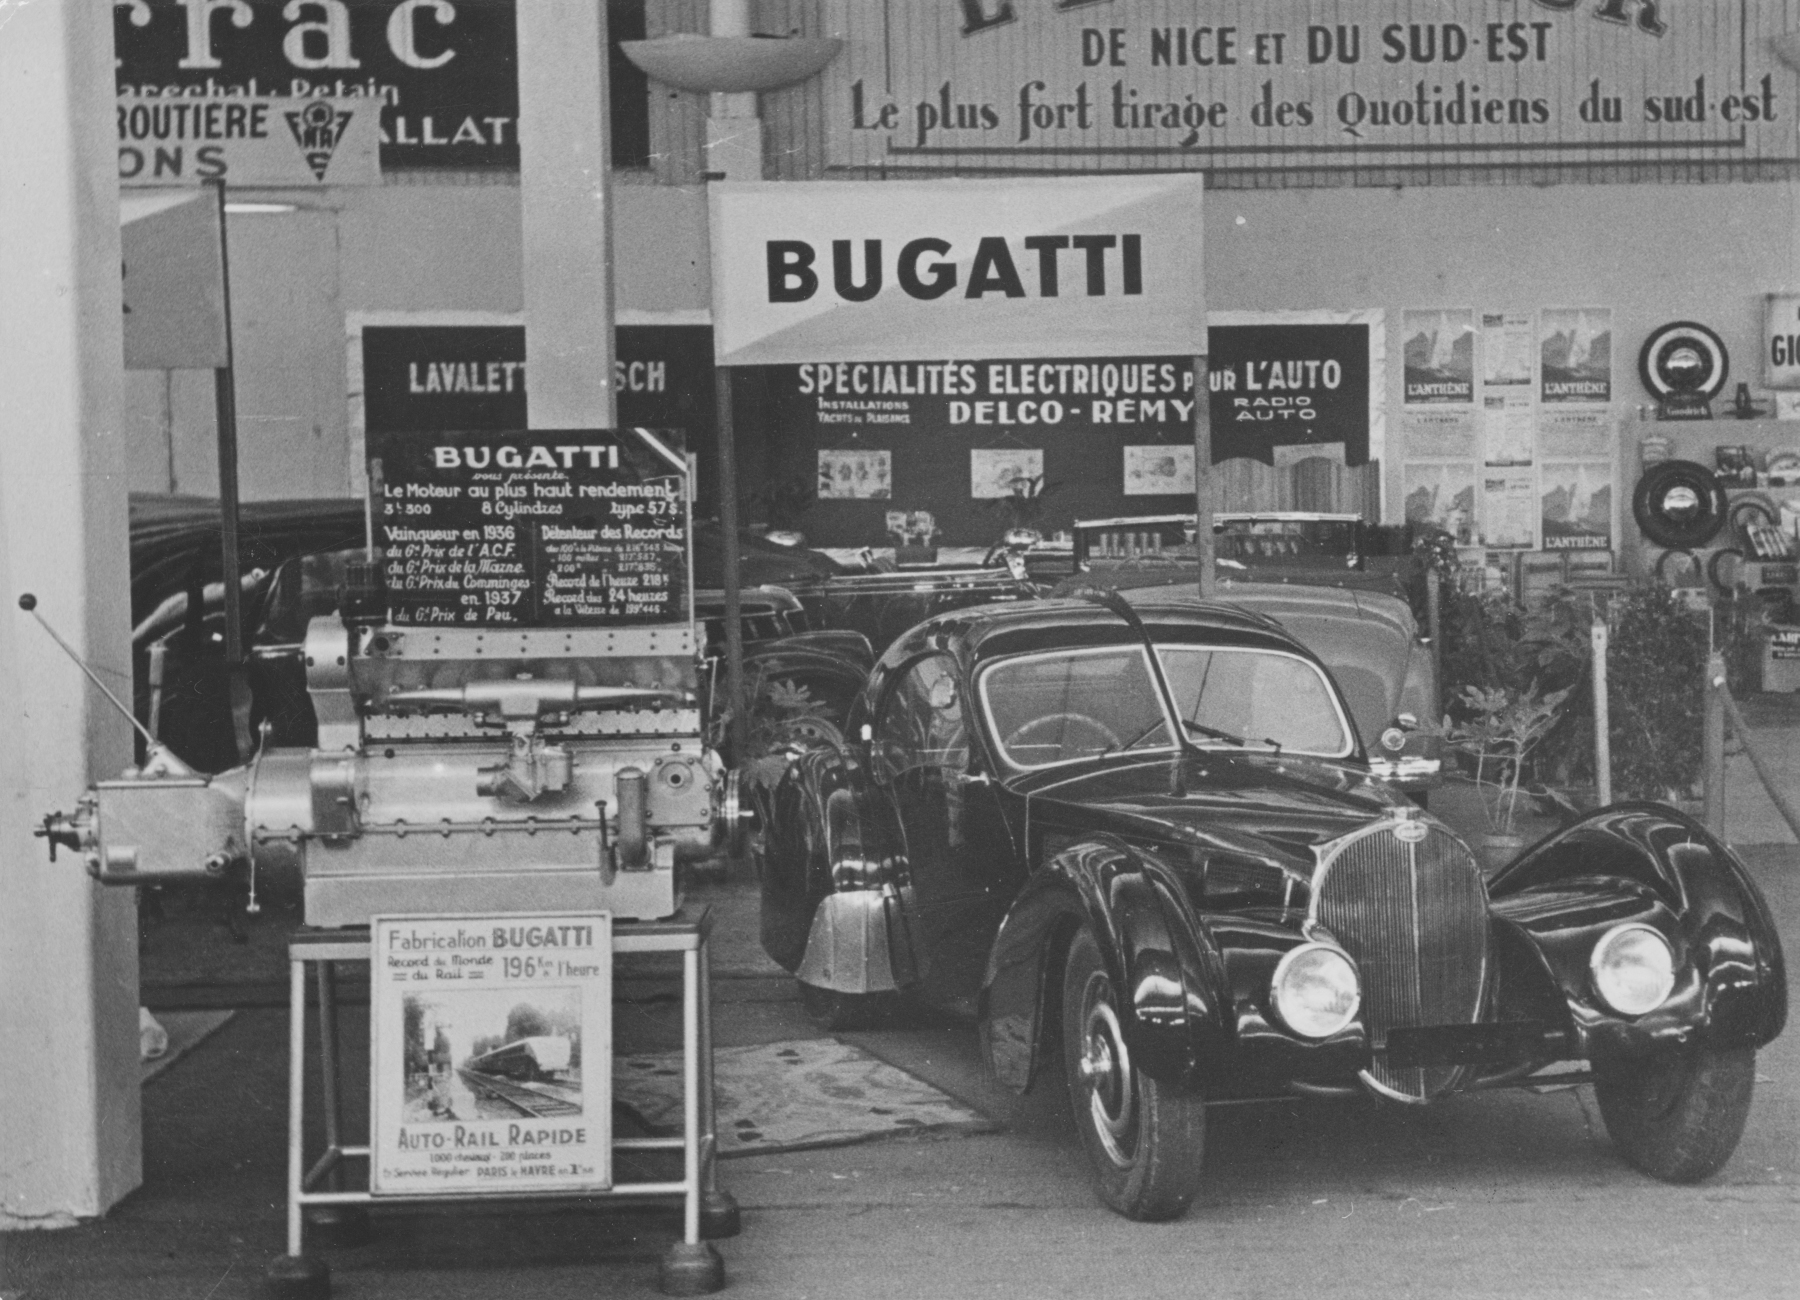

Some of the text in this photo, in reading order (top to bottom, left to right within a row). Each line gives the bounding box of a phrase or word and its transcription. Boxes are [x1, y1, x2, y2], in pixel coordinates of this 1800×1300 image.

[1082, 28, 1127, 66] DE
[1151, 26, 1237, 66] NICE
[1255, 33, 1287, 65] ET
[1308, 25, 1361, 64] DU
[852, 79, 900, 131] Le
[916, 80, 999, 148] plus
[1018, 80, 1093, 143] fort
[1112, 79, 1228, 148] tirage
[1250, 79, 1314, 128] des
[1337, 79, 1550, 138] Quotidiens
[1579, 78, 1623, 125] du
[380, 115, 519, 145] LLAT
[118, 146, 228, 179] ONS
[766, 234, 1143, 303] BUGATTI
[1772, 334, 1800, 367] GI
[988, 363, 1176, 397] ELECTRIQUES
[1184, 370, 1236, 392] PUR
[1247, 359, 1341, 390] L'AUTO
[1234, 396, 1311, 407] RADIO
[1235, 408, 1316, 420] AUTO
[434, 445, 619, 468] BUGATTI
[384, 479, 672, 501] Le Moteur au plus haut rendement
[495, 500, 563, 520] Cylindres
[610, 502, 645, 519] type
[384, 525, 516, 543] Vainqueur en 1936
[600, 525, 622, 539] des
[623, 524, 684, 539] Records
[386, 544, 402, 557] du
[421, 543, 446, 558] Prix
[448, 545, 464, 557] de
[387, 560, 403, 574] du
[420, 559, 447, 574] Prix
[448, 560, 463, 574] de
[463, 560, 476, 574] la
[419, 574, 445, 589] Prix
[445, 576, 460, 589] du
[589, 574, 600, 587] de
[460, 591, 522, 605] en 1937
[608, 588, 626, 602] 24
[628, 588, 669, 602] heures
[395, 606, 410, 621] du
[430, 606, 455, 621] Prix
[464, 607, 478, 621] de
[388, 925, 593, 950] Fabrication BUGATTI
[388, 955, 429, 967] Record
[451, 955, 494, 966] Monde
[502, 956, 536, 978] 196
[412, 969, 429, 980] du
[508, 1123, 587, 1146] RAPIDE
